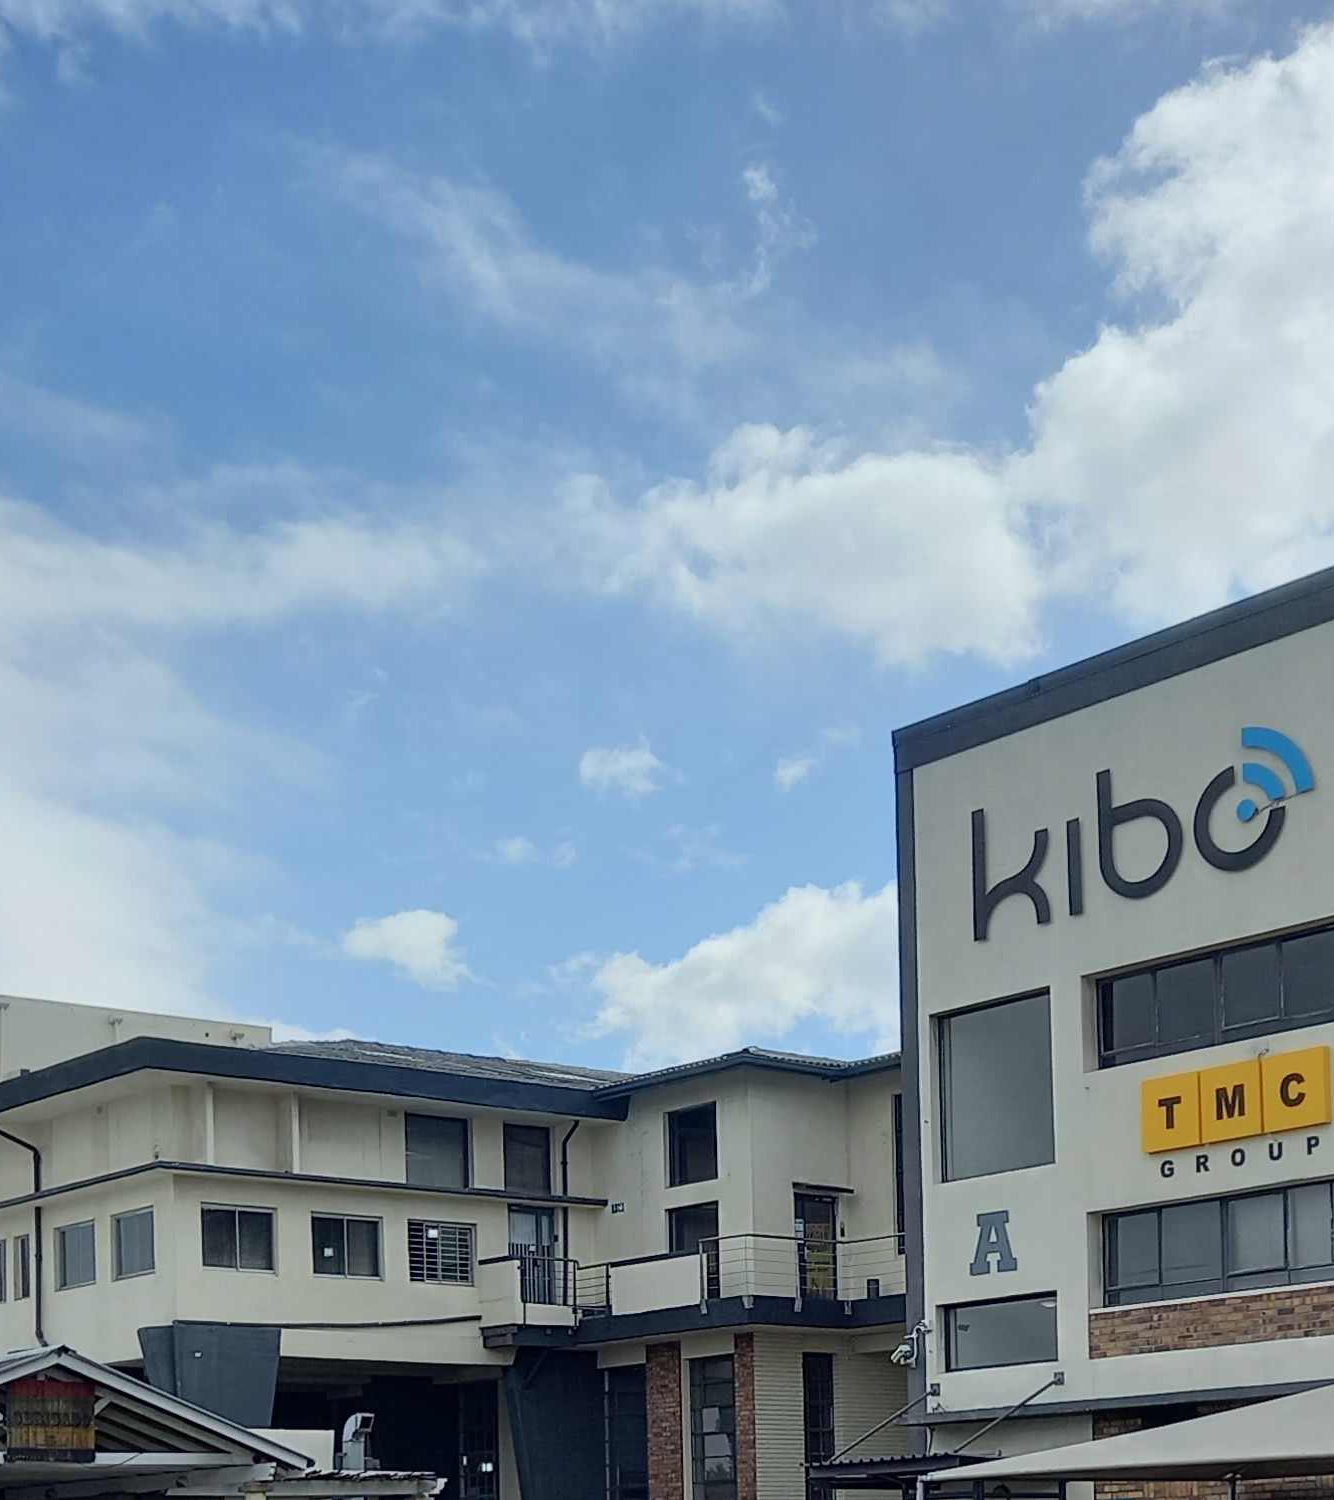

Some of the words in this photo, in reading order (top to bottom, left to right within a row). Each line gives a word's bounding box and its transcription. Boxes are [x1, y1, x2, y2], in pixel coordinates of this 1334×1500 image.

[1158, 1072, 1307, 1130] TMC
[1160, 1135, 1320, 1179] GROUP
[969, 1209, 1018, 1277] A
